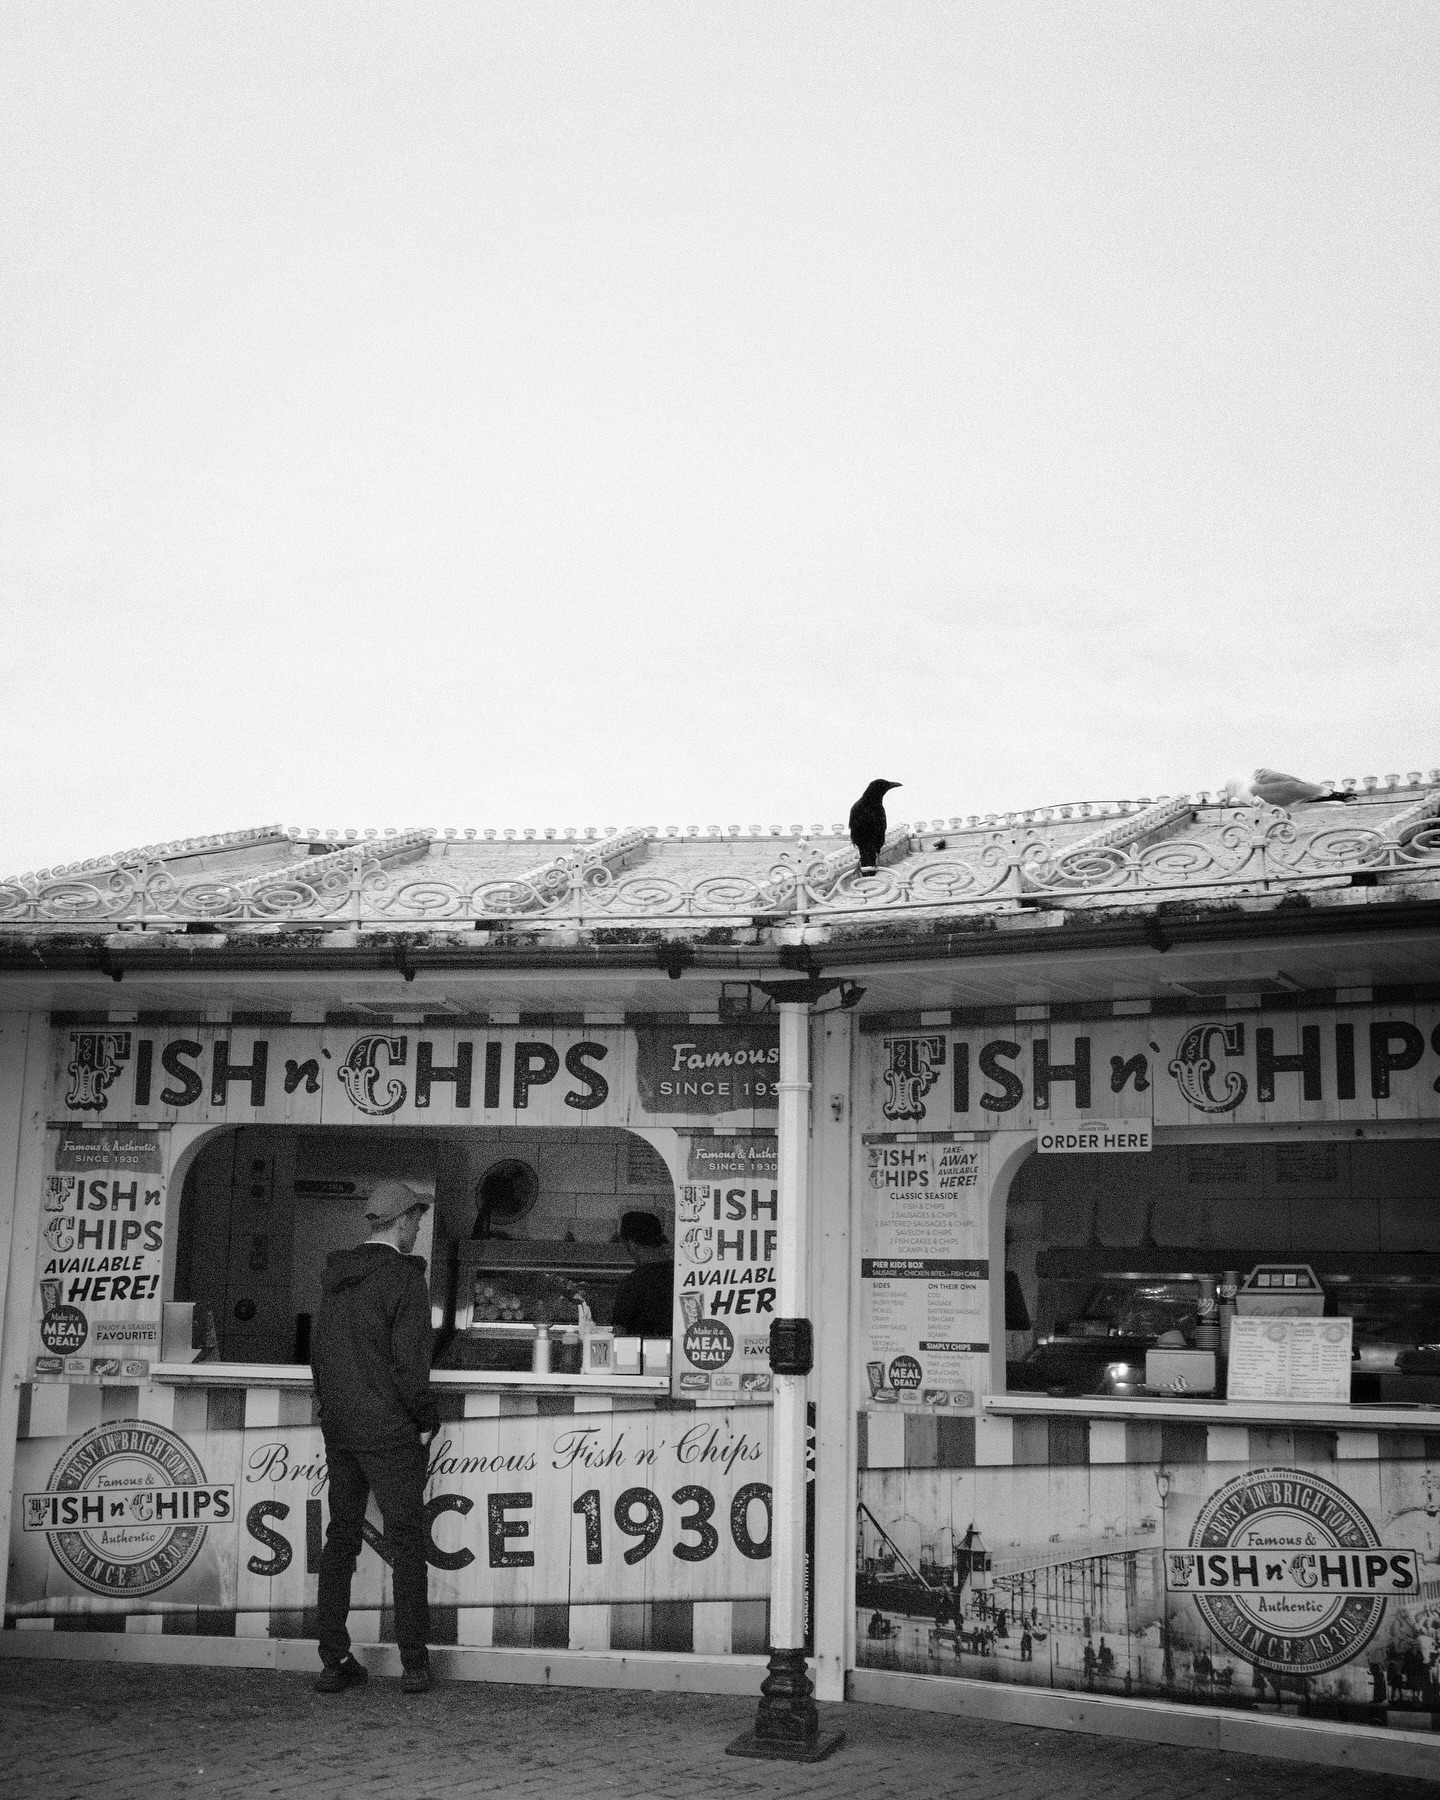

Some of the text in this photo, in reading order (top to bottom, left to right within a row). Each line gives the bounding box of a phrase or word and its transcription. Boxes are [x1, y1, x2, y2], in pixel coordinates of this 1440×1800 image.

[672, 1043, 779, 1071] Famous
[65, 1031, 268, 1112] FISH
[337, 1034, 609, 1116] CHIPS
[883, 1035, 1091, 1121] FISH
[1167, 1021, 1440, 1114] CHIP
[660, 1082, 779, 1096] SINCE 193
[64, 1140, 156, 1152] Famous & Authentic
[1041, 1133, 1149, 1149] ORDER HERE
[75, 1155, 139, 1163] SINCE 1930
[696, 1147, 778, 1159] Famous & Authe
[868, 1148, 915, 1168] FISH
[939, 1153, 978, 1167] AWAY
[709, 1163, 777, 1171] SINCE 1930
[938, 1166, 979, 1176] AVAILABLE
[868, 1169, 929, 1189] CHIPS
[940, 1175, 977, 1188] HERE!
[44, 1175, 137, 1212] FISH
[890, 1192, 959, 1200] CLASSIC SEASIDE
[679, 1184, 777, 1223] FISH
[43, 1215, 163, 1253] CHIPS
[679, 1226, 777, 1264] CHIP
[44, 1255, 145, 1274] AVAILABLE
[872, 1261, 889, 1269] PIER
[890, 1261, 907, 1269] KIDS
[683, 1267, 777, 1288] AVAILABL
[68, 1275, 161, 1302] HERE!
[710, 1287, 777, 1316] HER
[51, 1313, 68, 1321] Make
[43, 1322, 85, 1336] MEAL
[97, 1331, 157, 1341] FAVOURITE!
[694, 1326, 712, 1335] Make
[48, 1336, 79, 1346] DEAL!
[686, 1336, 731, 1350] MEAL
[926, 1342, 971, 1351] SIMPLY CHIPS
[692, 1351, 725, 1361] DEAL!
[890, 1368, 921, 1379] MEAL
[894, 1379, 917, 1387] DEAL!
[66, 1431, 189, 1481] BEST IN BRIGHTON
[552, 1428, 626, 1470] Fish
[671, 1423, 763, 1476] Chips
[97, 1473, 154, 1488] Famous &
[28, 1495, 104, 1527] FISH
[130, 1489, 230, 1522] CHIPS
[1210, 1481, 1357, 1538] BEST IN BRIGHTON
[573, 1482, 773, 1566] 1930
[101, 1529, 156, 1545] Authentic
[1247, 1532, 1317, 1546] Famous &
[73, 1544, 182, 1586] SINCE 1930
[1169, 1553, 1259, 1587] FISH
[1288, 1553, 1414, 1588] CHIPS
[1258, 1596, 1324, 1613] Authentic
[1227, 1615, 1358, 1662] SINCE 1930
